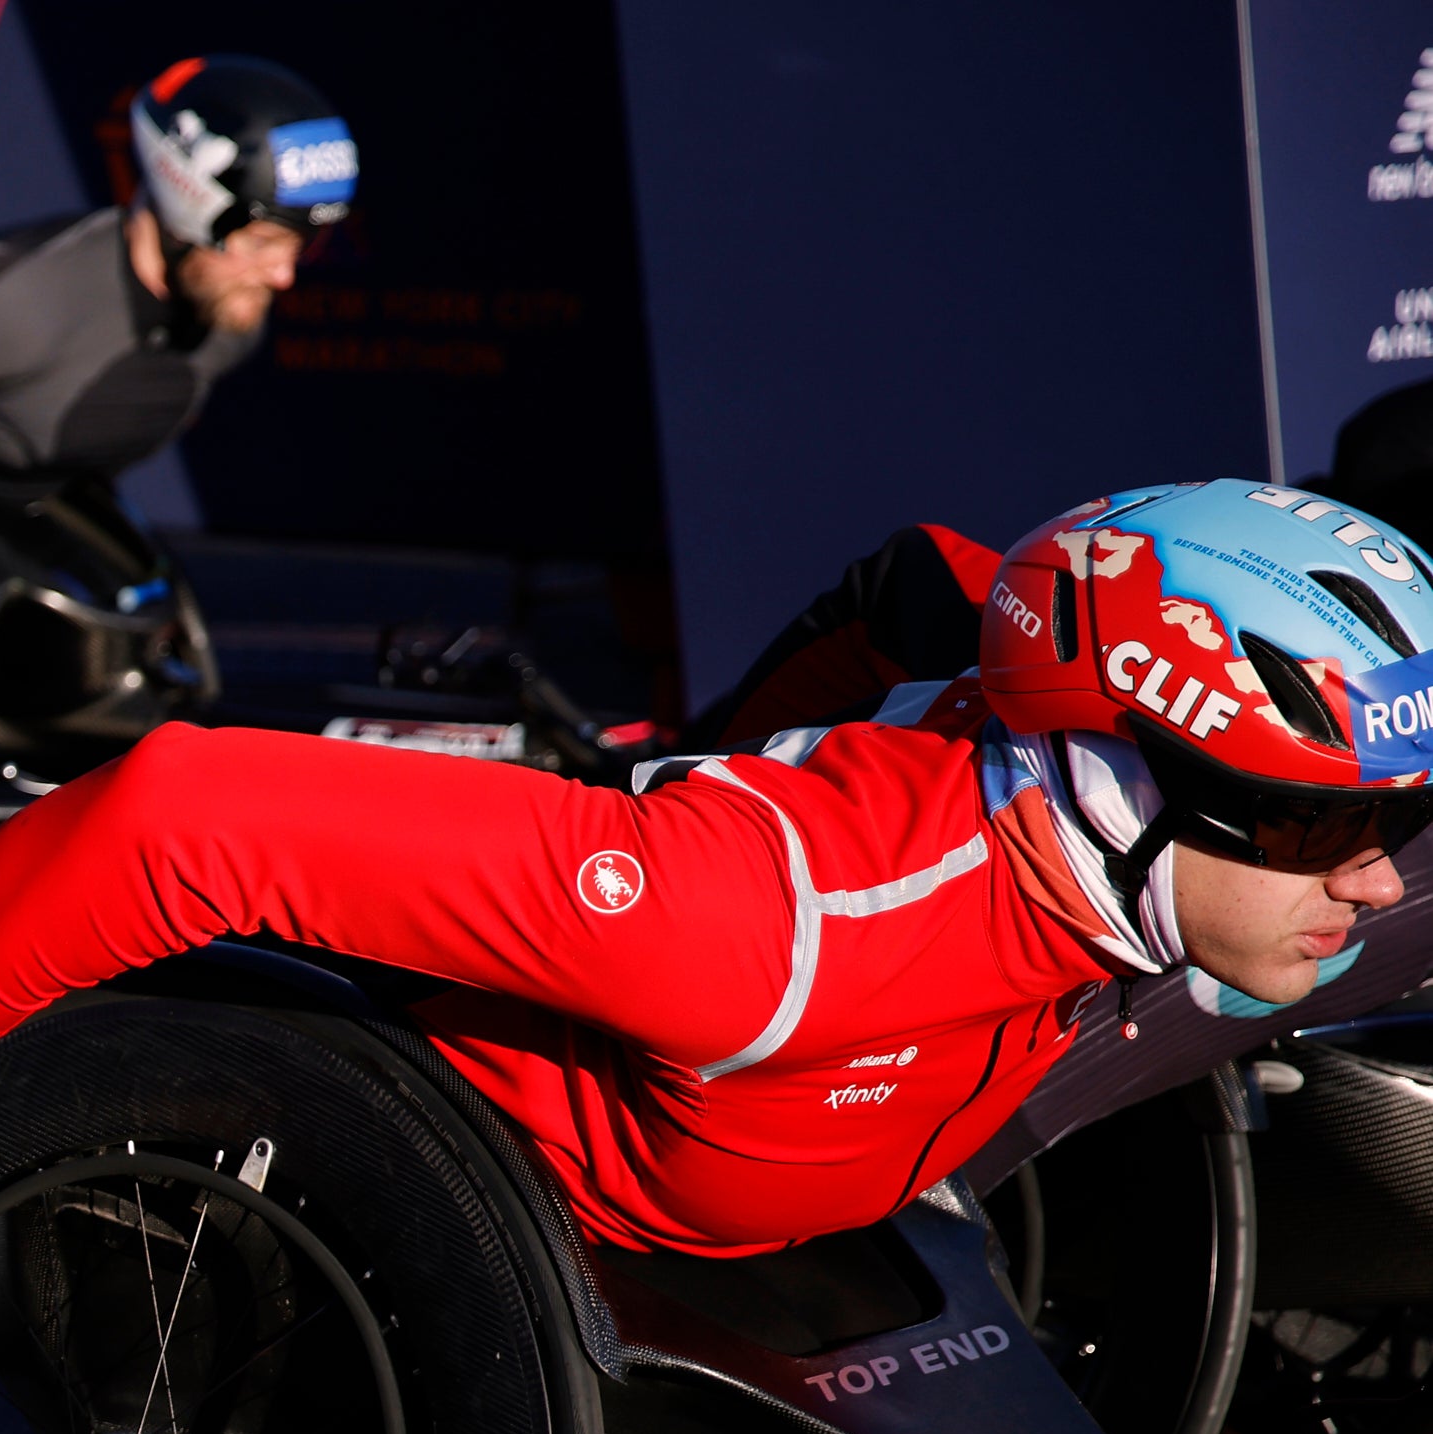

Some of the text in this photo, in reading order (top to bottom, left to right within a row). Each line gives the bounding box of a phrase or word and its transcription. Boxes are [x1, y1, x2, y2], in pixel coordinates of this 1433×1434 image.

[993, 581, 1042, 638] GIRO
[1173, 537, 1216, 557] BEFORE
[1216, 551, 1270, 581] SOMEONE
[1271, 576, 1305, 603] TELLS
[1307, 600, 1340, 627] THEM
[1339, 623, 1366, 651] THEY
[1240, 548, 1357, 627] TEACH KIDS THEY CAN
[1107, 640, 1242, 740] CLIF
[805, 1325, 1010, 1402] TOP END
